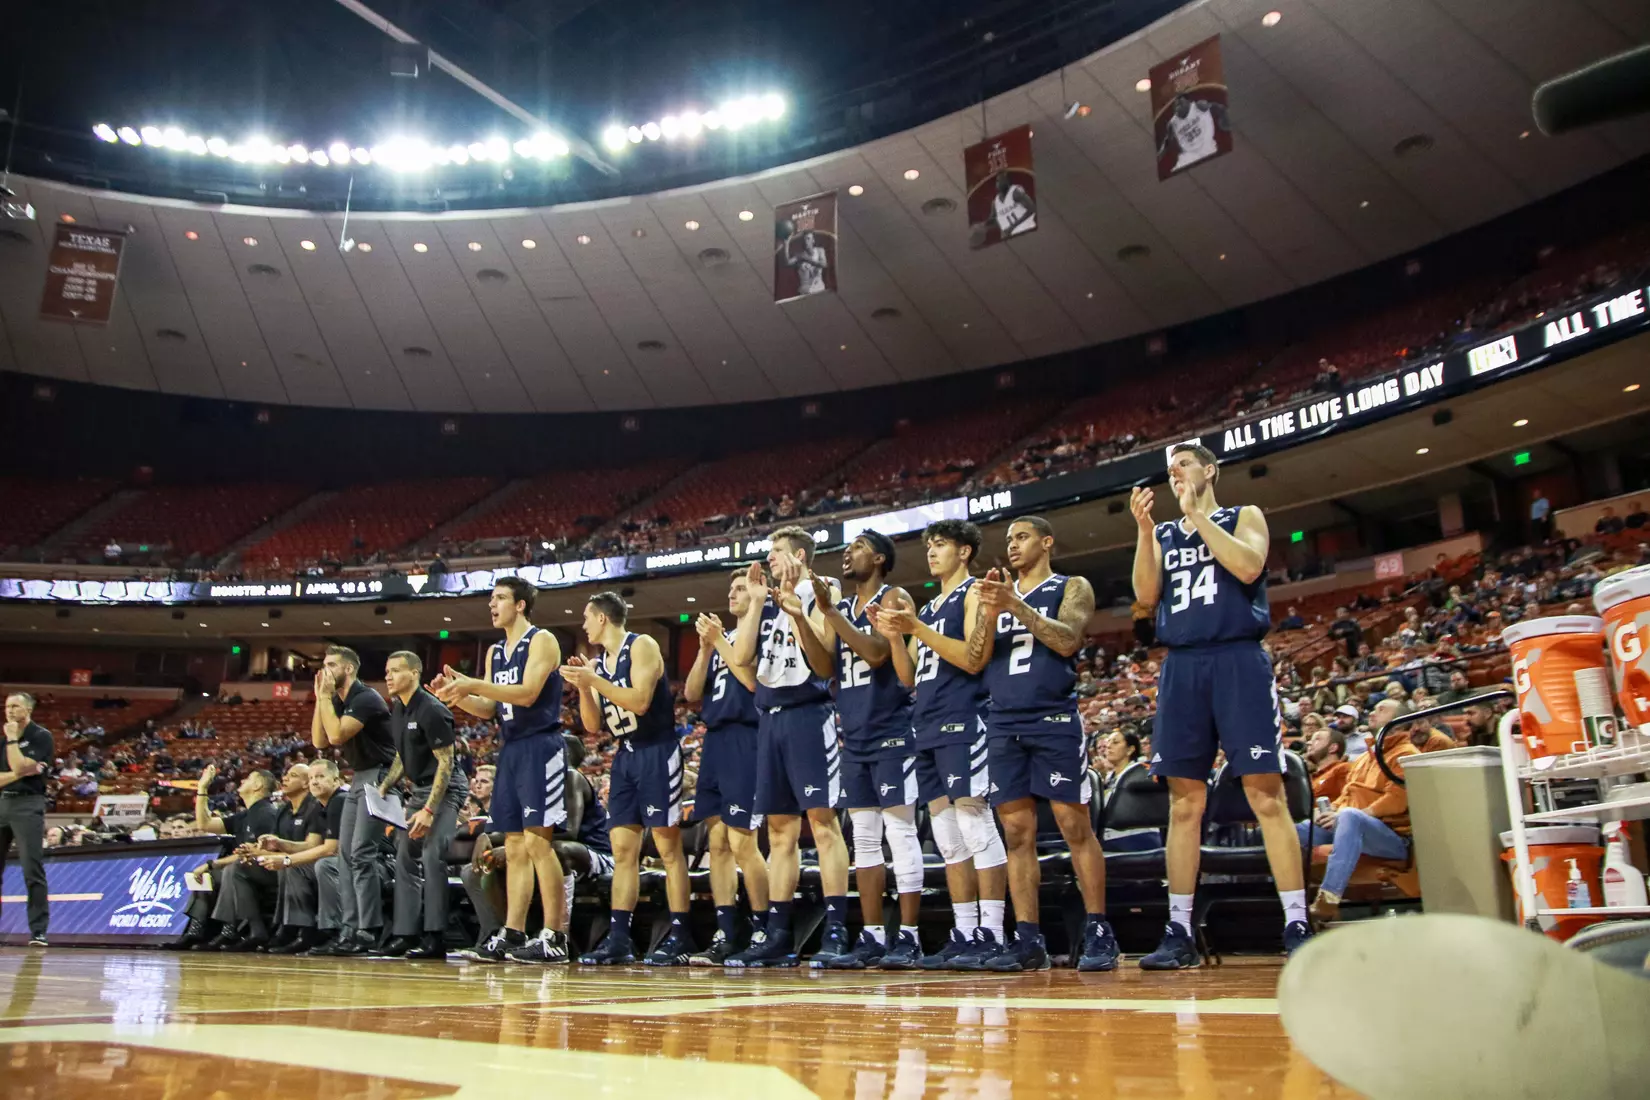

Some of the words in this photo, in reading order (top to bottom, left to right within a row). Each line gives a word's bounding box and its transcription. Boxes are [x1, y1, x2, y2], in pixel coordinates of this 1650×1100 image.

[69, 233, 110, 247] TEXAS
[1544, 311, 1591, 348] ALL
[1590, 288, 1646, 328] THE
[1224, 424, 1256, 452] ALL
[1259, 411, 1295, 440] THE
[1300, 397, 1343, 430] LIVE
[1347, 378, 1400, 416] LONG
[1402, 362, 1444, 397] DAY
[646, 550, 703, 569] MONSTER
[704, 546, 730, 561] JAM
[1378, 558, 1399, 574] 49
[210, 585, 266, 597] MONSTER
[267, 584, 292, 596] JAM
[306, 583, 340, 595] APRIL
[1171, 564, 1218, 615] 34
[1008, 633, 1034, 676] 2
[1614, 621, 1643, 662] G
[712, 667, 729, 702] 5
[840, 650, 872, 690] 32
[1513, 657, 1532, 694] G
[274, 685, 289, 697] 23
[604, 704, 638, 737] 25
[1599, 720, 1614, 739] G
[109, 914, 139, 928] WORLD
